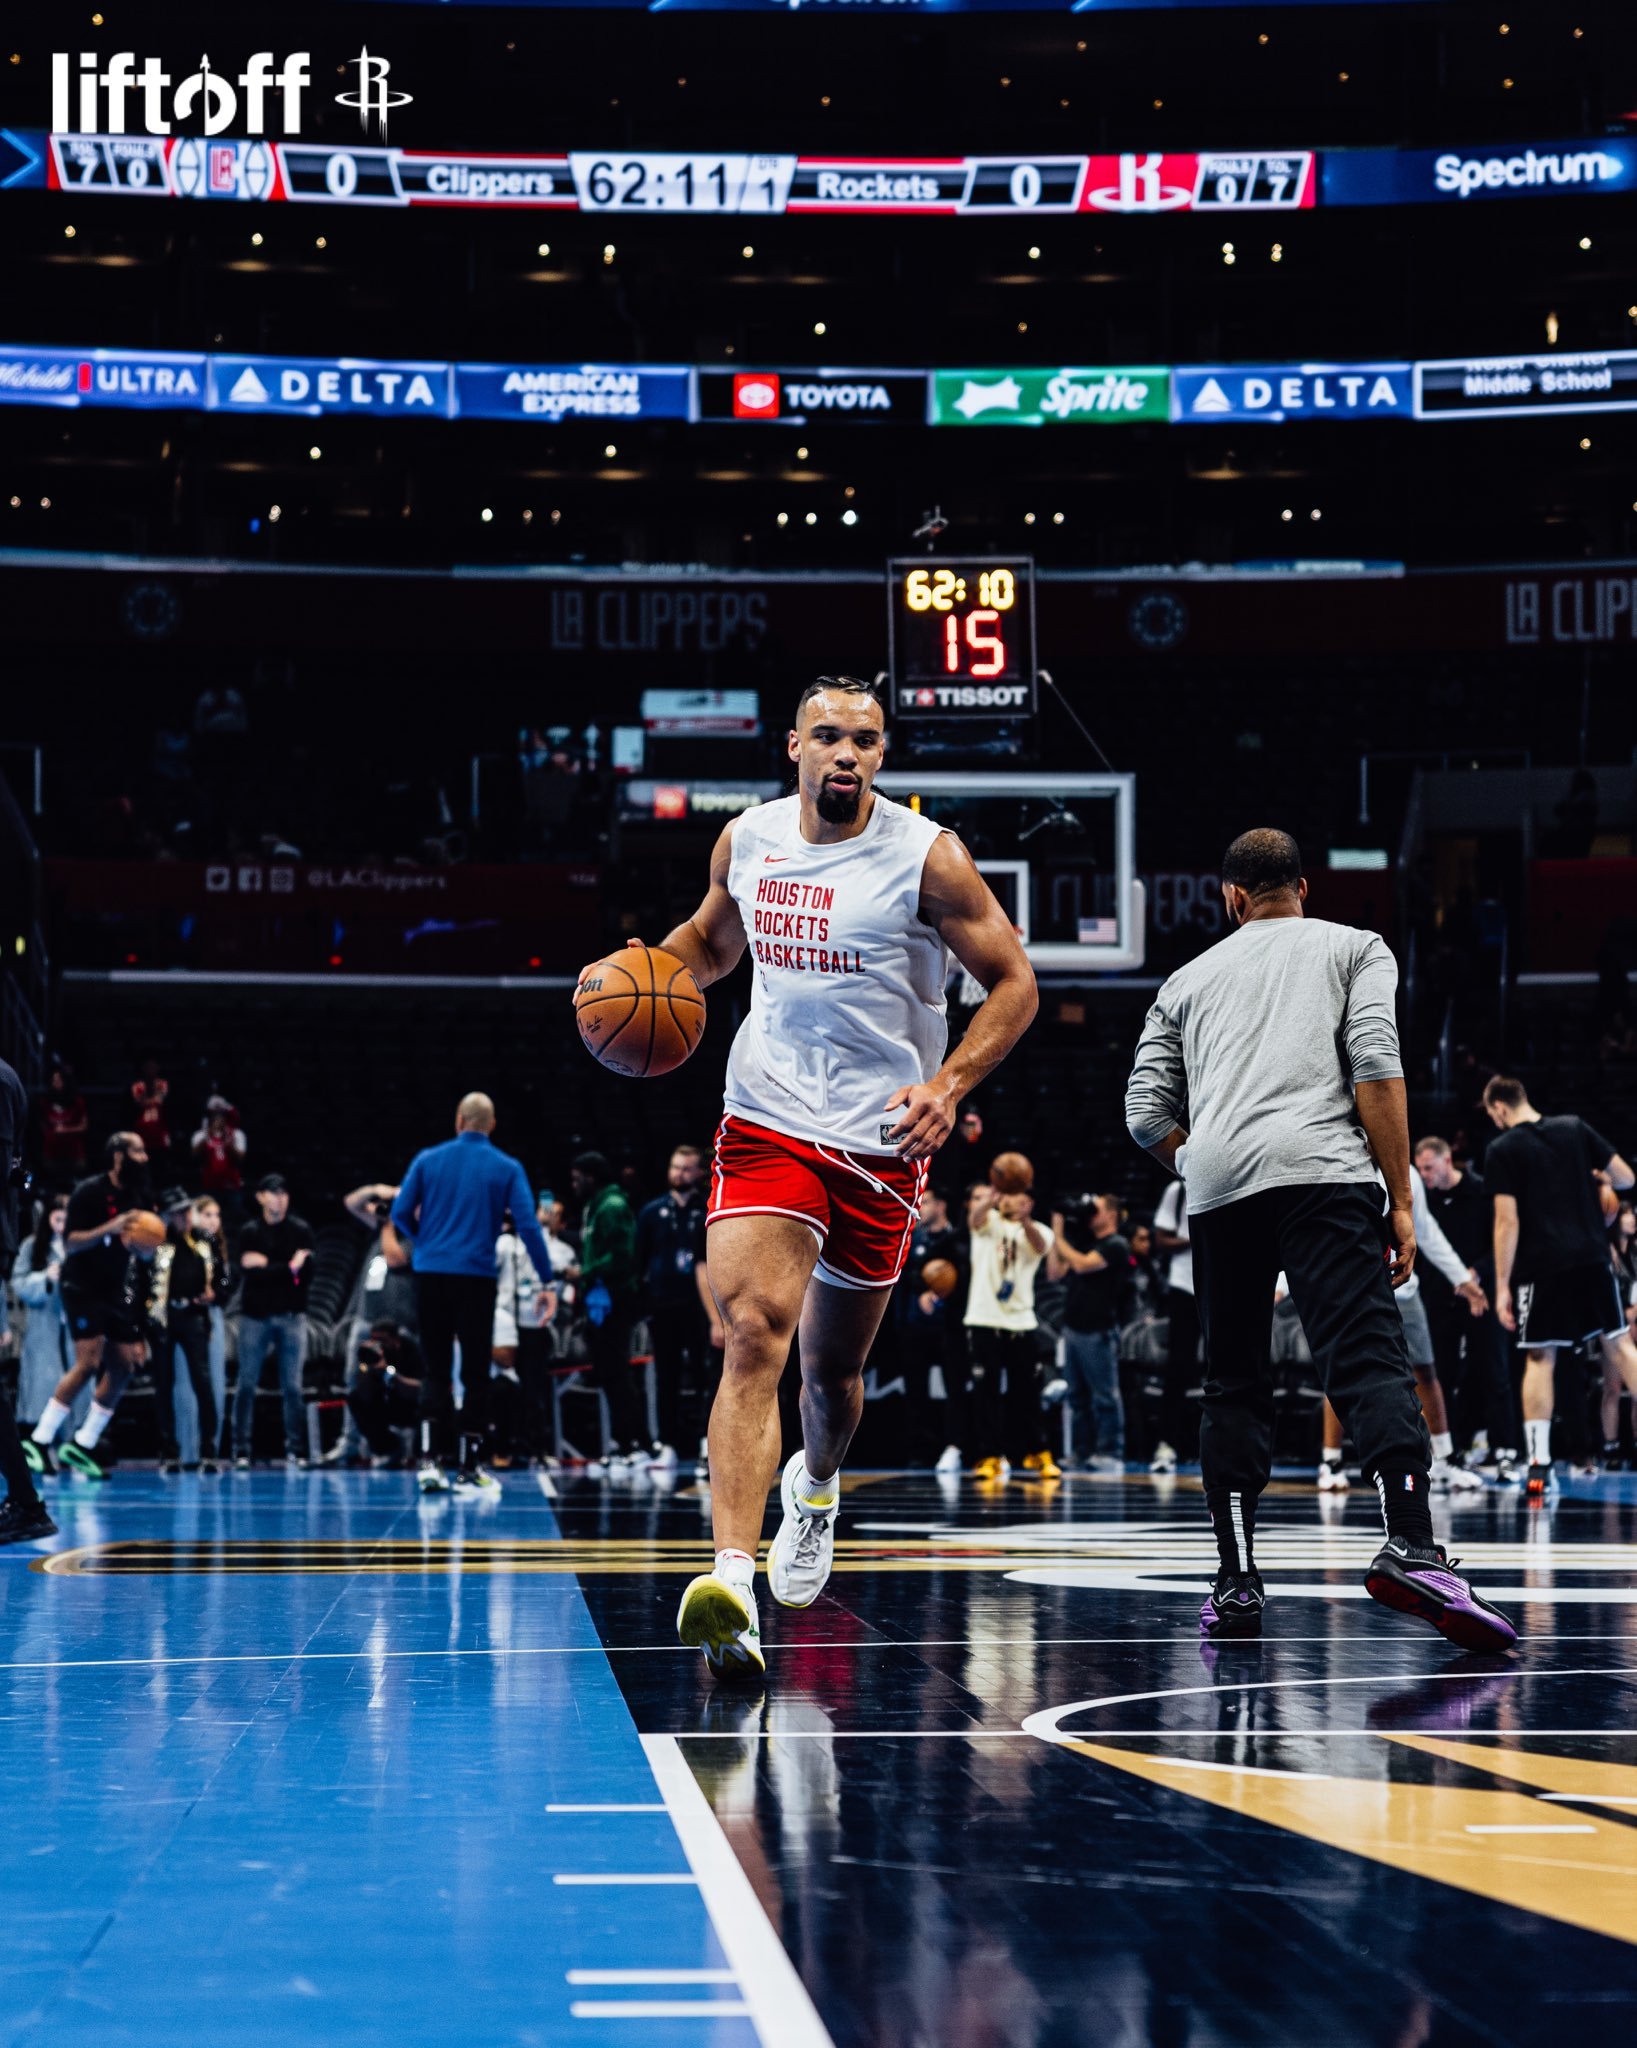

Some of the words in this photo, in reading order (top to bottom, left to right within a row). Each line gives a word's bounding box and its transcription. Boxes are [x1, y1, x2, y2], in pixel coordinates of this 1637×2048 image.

[78, 158, 98, 186] 7
[127, 158, 149, 187] 0
[326, 157, 357, 196] 0
[427, 165, 554, 196] Clippers
[589, 160, 730, 206] 62:11
[817, 171, 939, 200] Rockets
[1010, 165, 1041, 207] 0
[1435, 151, 1609, 196] Spectrum
[760, 177, 775, 208] 1
[1216, 175, 1237, 203] 0
[1267, 175, 1289, 201] 7
[97, 366, 198, 394] ULTRA
[281, 370, 434, 405] DELTA
[503, 372, 639, 393] AMERICAN
[1243, 377, 1397, 408] DELTA
[1464, 374, 1531, 396] Middle
[1540, 368, 1612, 393] School
[522, 394, 641, 416] EXPRESS
[784, 384, 891, 409] TOYOTA
[1041, 376, 1148, 417] Sprite
[907, 569, 1014, 611] 62:10
[597, 590, 767, 650] CLIPPERS
[1505, 581, 1540, 643] LA
[946, 610, 1004, 675] 15
[936, 687, 1028, 706] TISSOT
[757, 879, 834, 910] HOUSTON
[755, 910, 829, 942] ROCKETS
[755, 940, 865, 973] BASKETBALL
